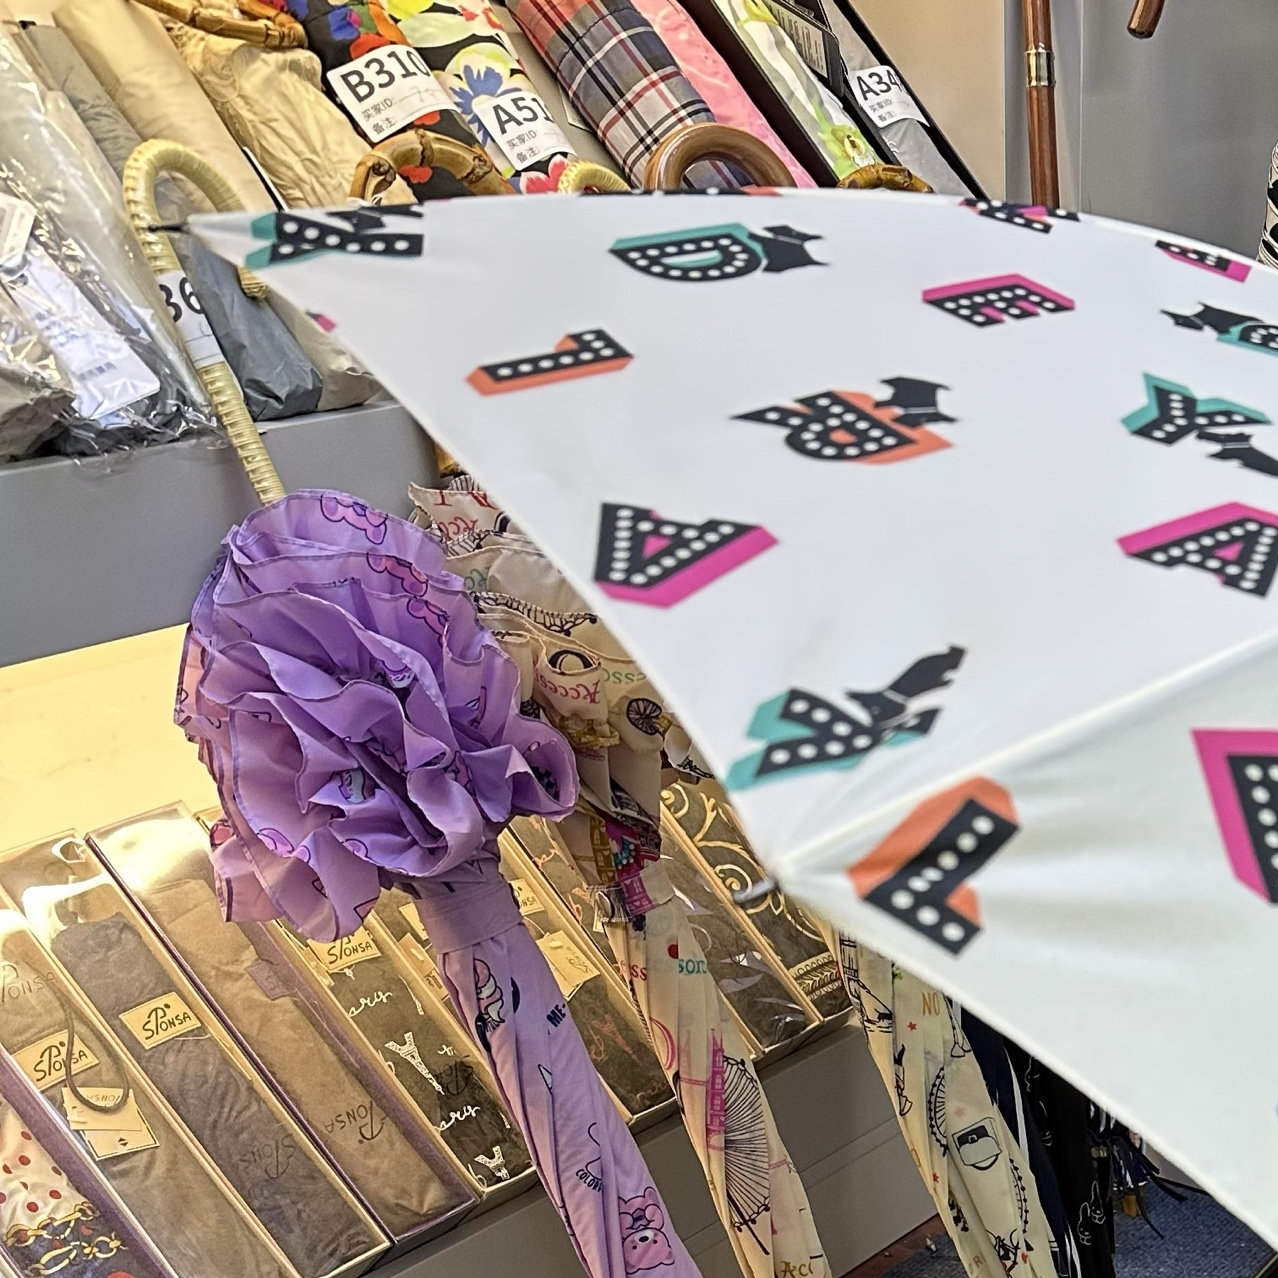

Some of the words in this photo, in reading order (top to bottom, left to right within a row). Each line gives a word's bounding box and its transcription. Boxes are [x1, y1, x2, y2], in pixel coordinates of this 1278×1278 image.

[340, 50, 431, 104] B310
[856, 69, 909, 101] A34
[608, 222, 764, 284] D
[921, 273, 1075, 328] E
[1120, 371, 1272, 445] Y
[594, 501, 780, 610] A
[846, 775, 1021, 957] L
[142, 1003, 192, 1040] SPONSA
[34, 1041, 88, 1083] SPOSA
